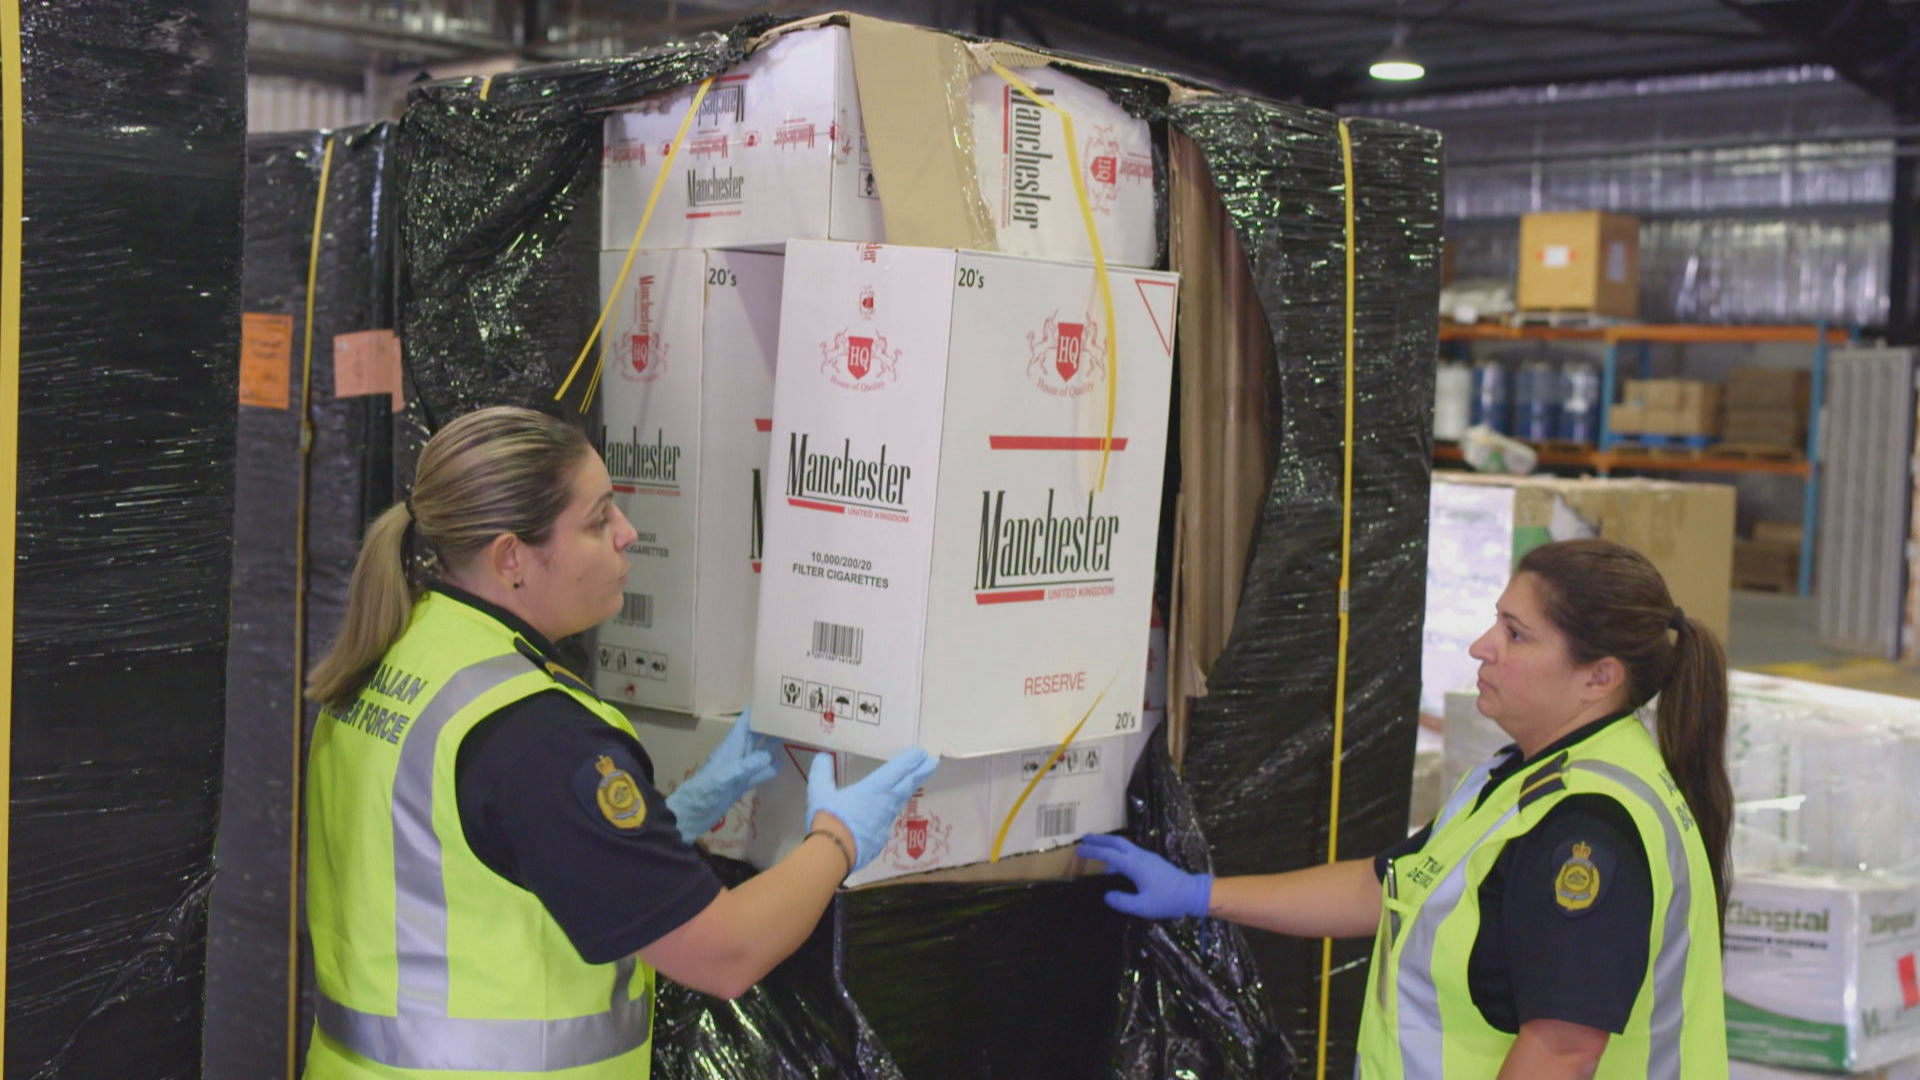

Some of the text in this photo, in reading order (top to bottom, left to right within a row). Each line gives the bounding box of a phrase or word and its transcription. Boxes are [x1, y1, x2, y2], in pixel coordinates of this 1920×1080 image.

[1010, 85, 1054, 229] Manchester
[1097, 159, 1112, 180] HQ
[686, 165, 744, 208] Manchester
[708, 268, 737, 286] 20's
[958, 268, 984, 288] 20's
[850, 345, 870, 372] HQ
[1057, 335, 1081, 369] HQ
[786, 432, 911, 504] Manchester
[848, 506, 909, 523] UNITED KINGDOM
[974, 488, 1119, 590] Manchester
[811, 551, 872, 571] 10,000/200/20
[792, 563, 889, 589] FILTER CIGARETTES
[1024, 672, 1087, 696] RESERVE
[357, 702, 410, 746] FORCE
[1115, 711, 1136, 730] 20's
[909, 829, 926, 849] HQ
